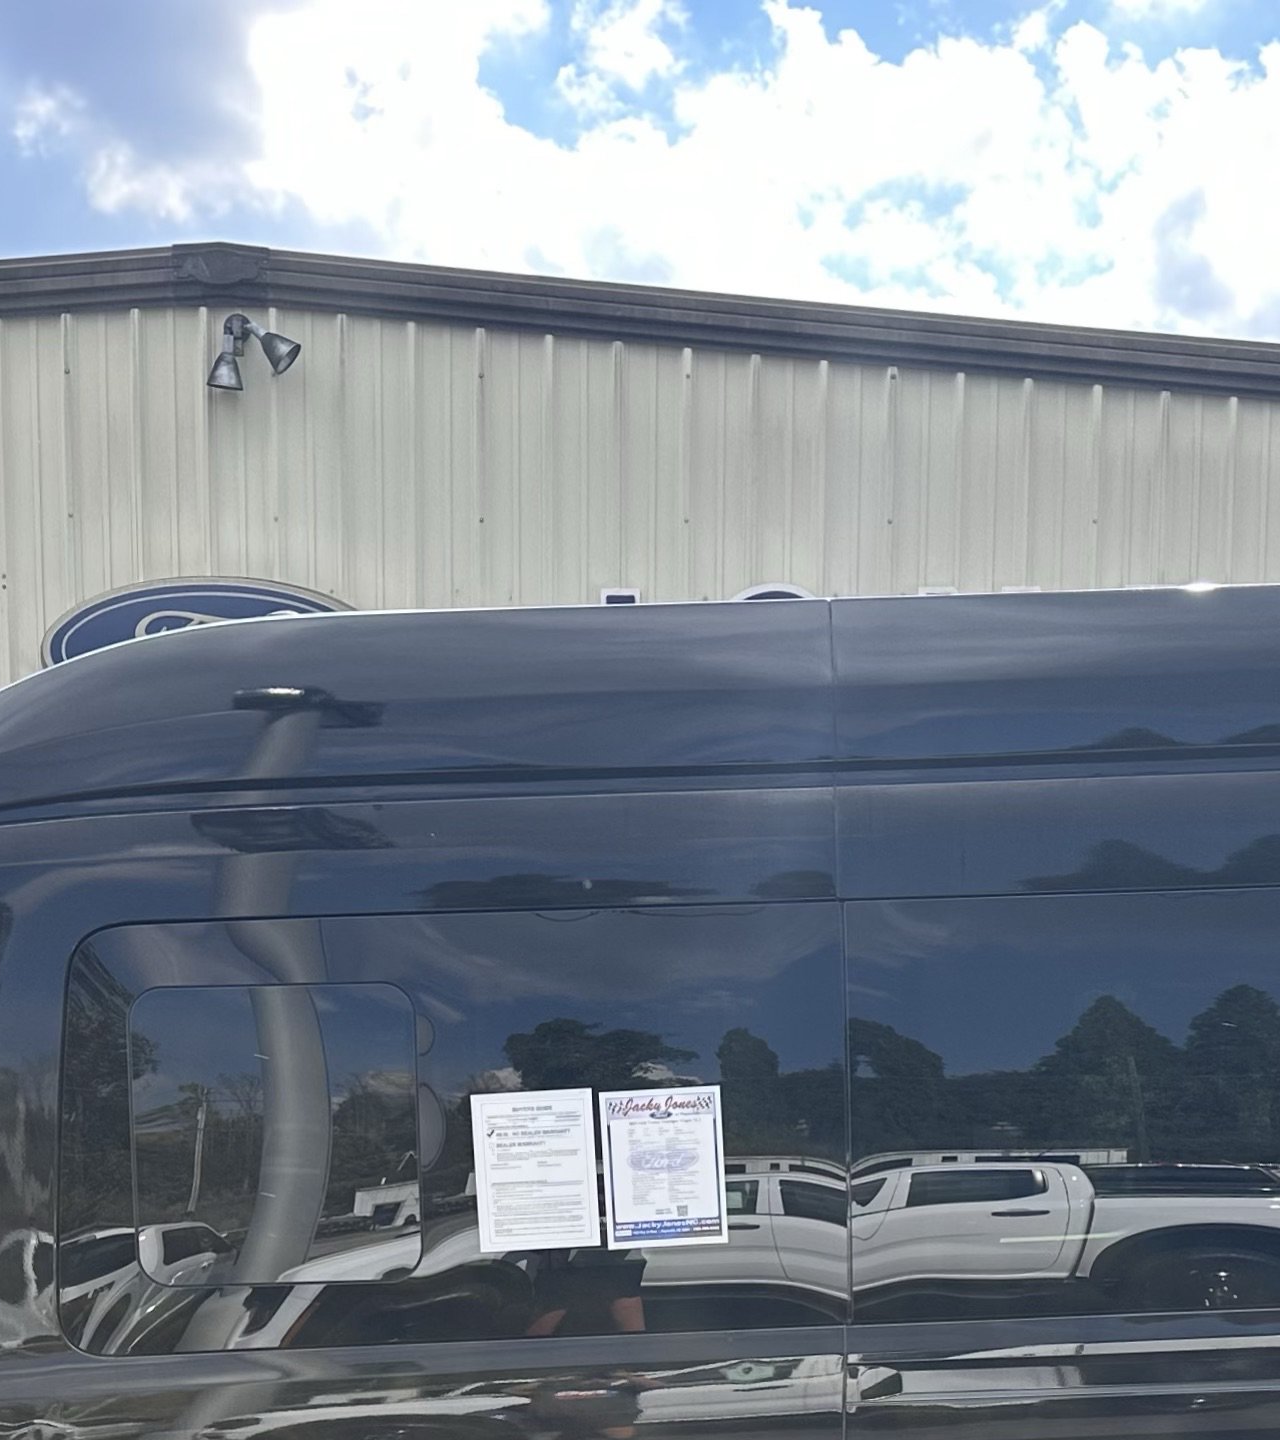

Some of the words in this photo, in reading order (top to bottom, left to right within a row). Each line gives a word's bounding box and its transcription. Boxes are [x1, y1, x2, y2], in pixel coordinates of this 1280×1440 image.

[623, 1097, 660, 1116] Jacky
[664, 1095, 698, 1113] Jones
[640, 1152, 684, 1169] Ford
